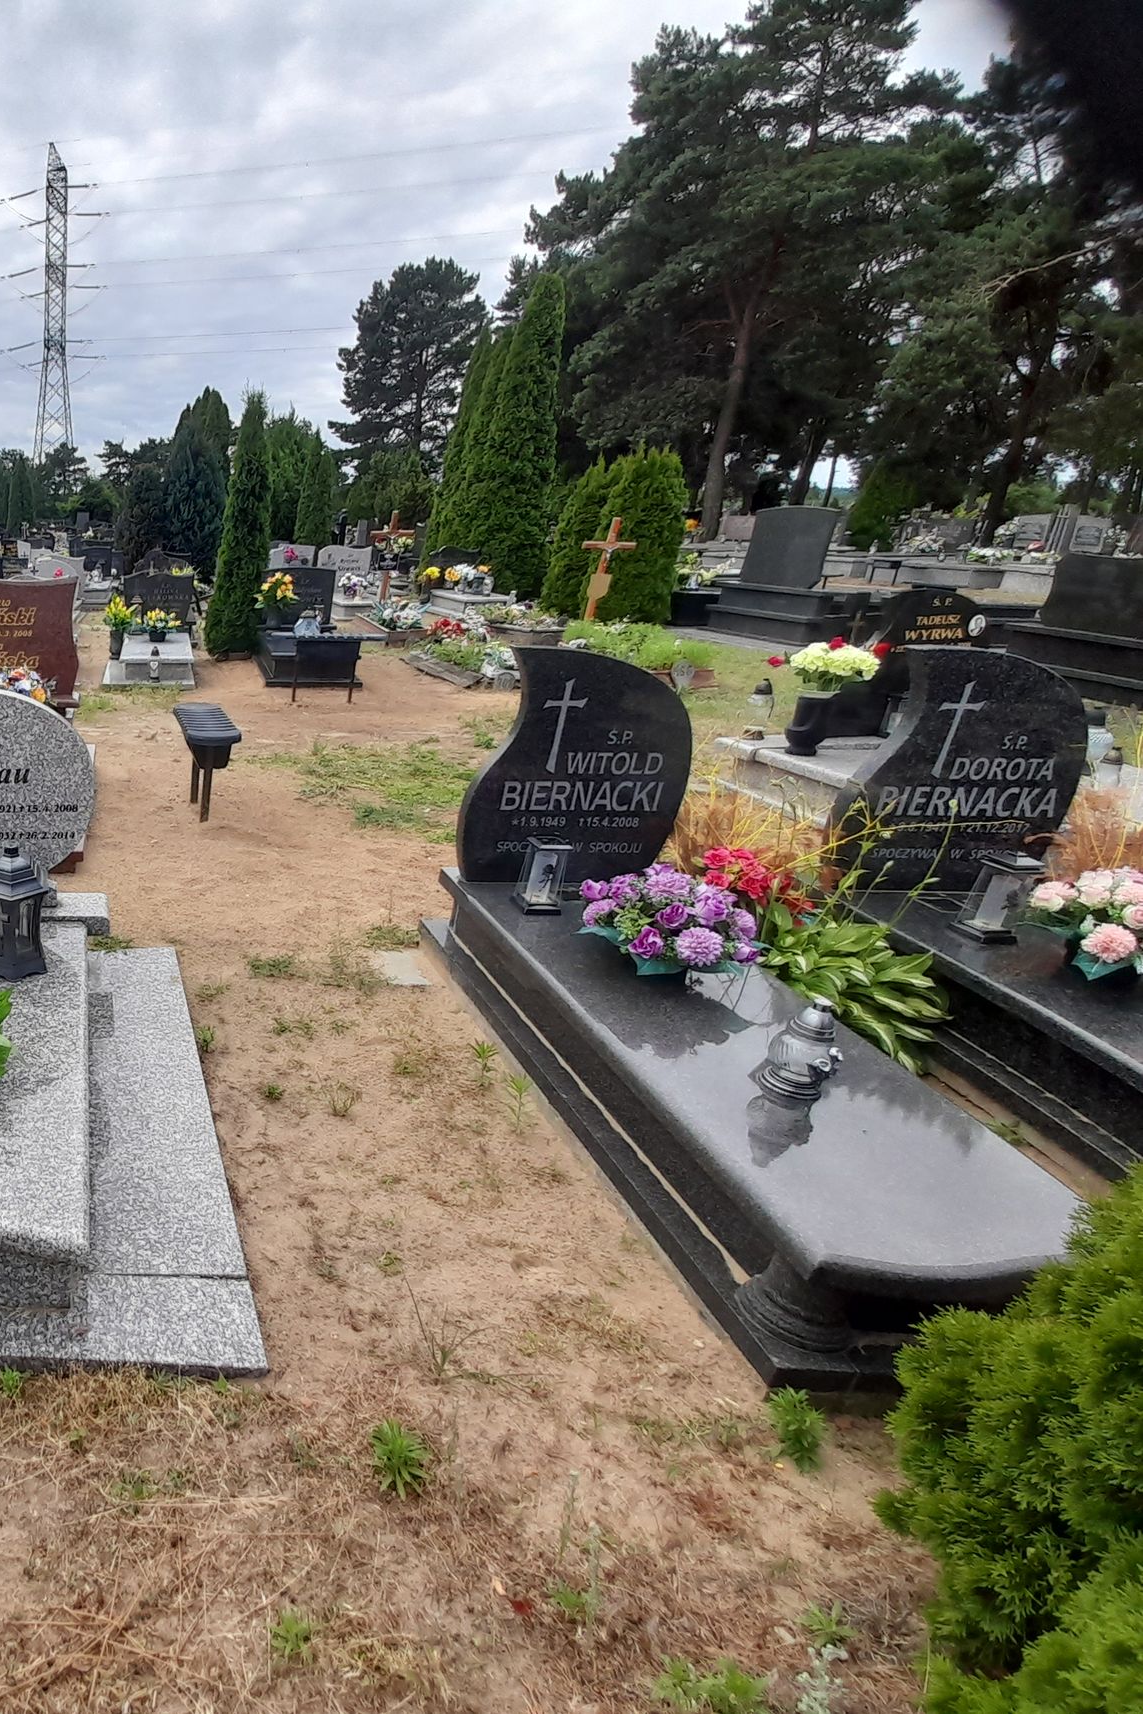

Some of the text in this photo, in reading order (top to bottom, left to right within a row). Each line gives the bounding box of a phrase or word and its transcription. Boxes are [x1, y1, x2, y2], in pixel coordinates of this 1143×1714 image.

[916, 614, 962, 626] TADEUSZ
[904, 628, 963, 641] WYRWA
[567, 752, 664, 775] WITOLD
[948, 757, 1057, 781] DOROTA
[499, 781, 665, 812] BIERNACKI
[589, 842, 643, 854] SPOKOJU
[950, 848, 964, 860] W
